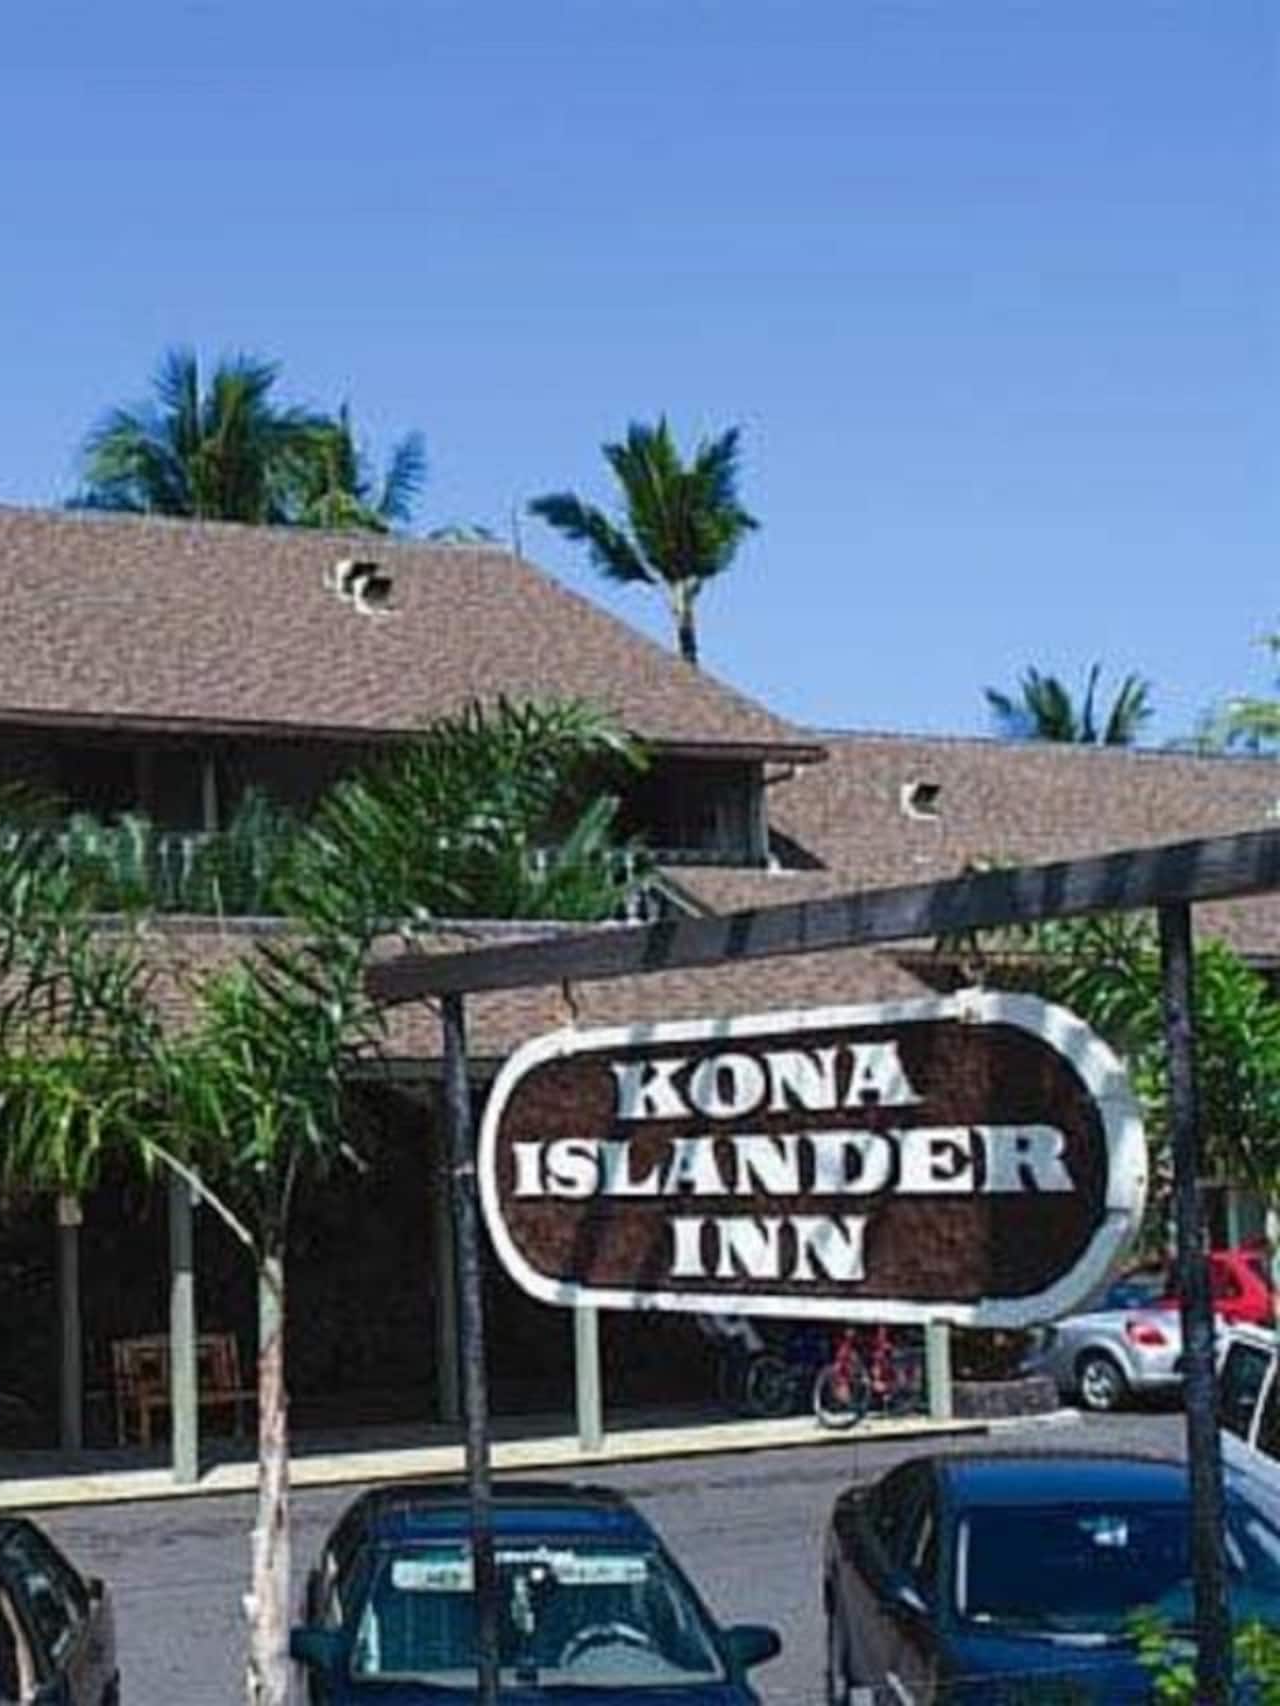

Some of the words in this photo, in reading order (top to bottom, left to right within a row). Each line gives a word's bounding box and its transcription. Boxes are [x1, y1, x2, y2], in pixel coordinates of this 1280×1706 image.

[613, 1041, 921, 1120] KONA
[513, 1124, 1075, 1197] ISLANDER
[671, 1215, 868, 1281] INN
